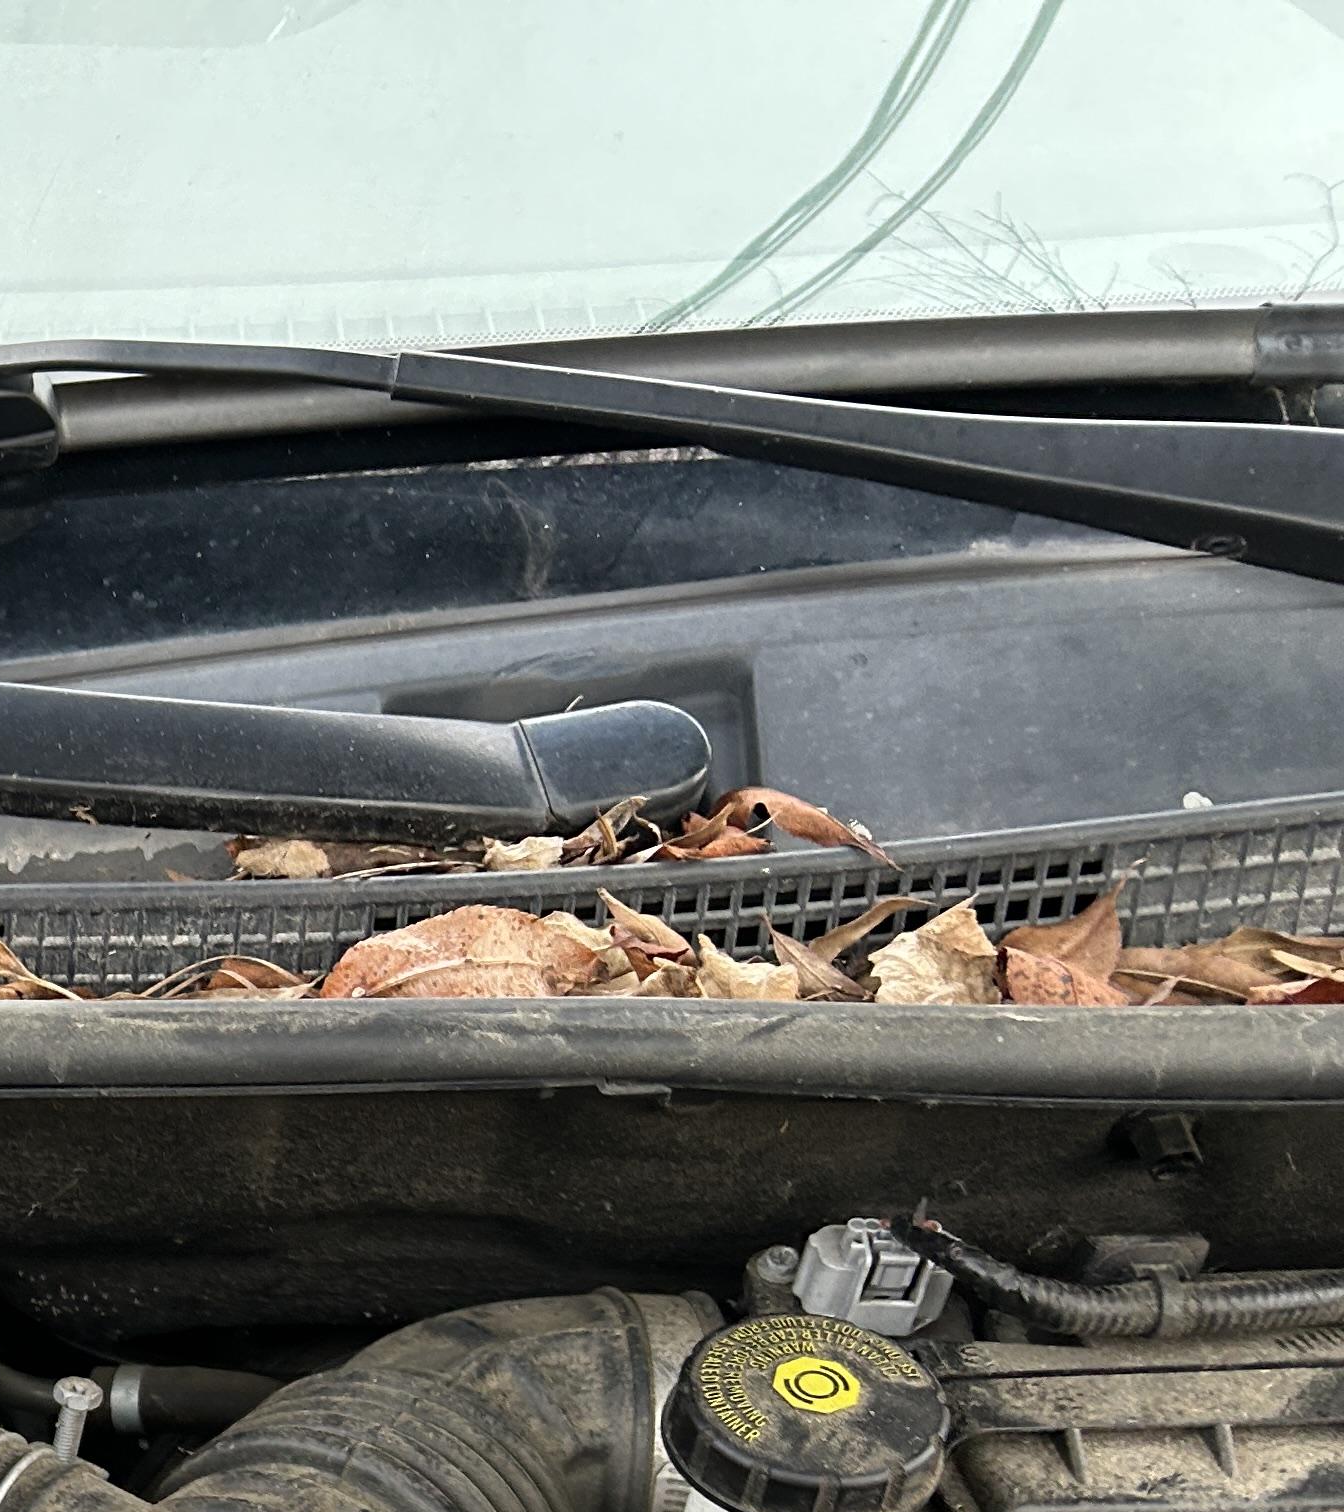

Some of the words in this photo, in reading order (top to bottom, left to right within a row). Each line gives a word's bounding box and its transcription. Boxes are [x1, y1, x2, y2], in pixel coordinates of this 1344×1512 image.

[728, 1321, 769, 1341] FROM
[768, 1328, 797, 1343] CAP
[771, 1316, 815, 1330] FLUID
[801, 1328, 857, 1349] FILLER
[700, 1346, 728, 1383] SEALED
[749, 1341, 817, 1370] WARNING
[857, 1343, 901, 1377] CLEAN
[702, 1384, 761, 1442] CONTAINER
[723, 1372, 767, 1428] REMOVING
